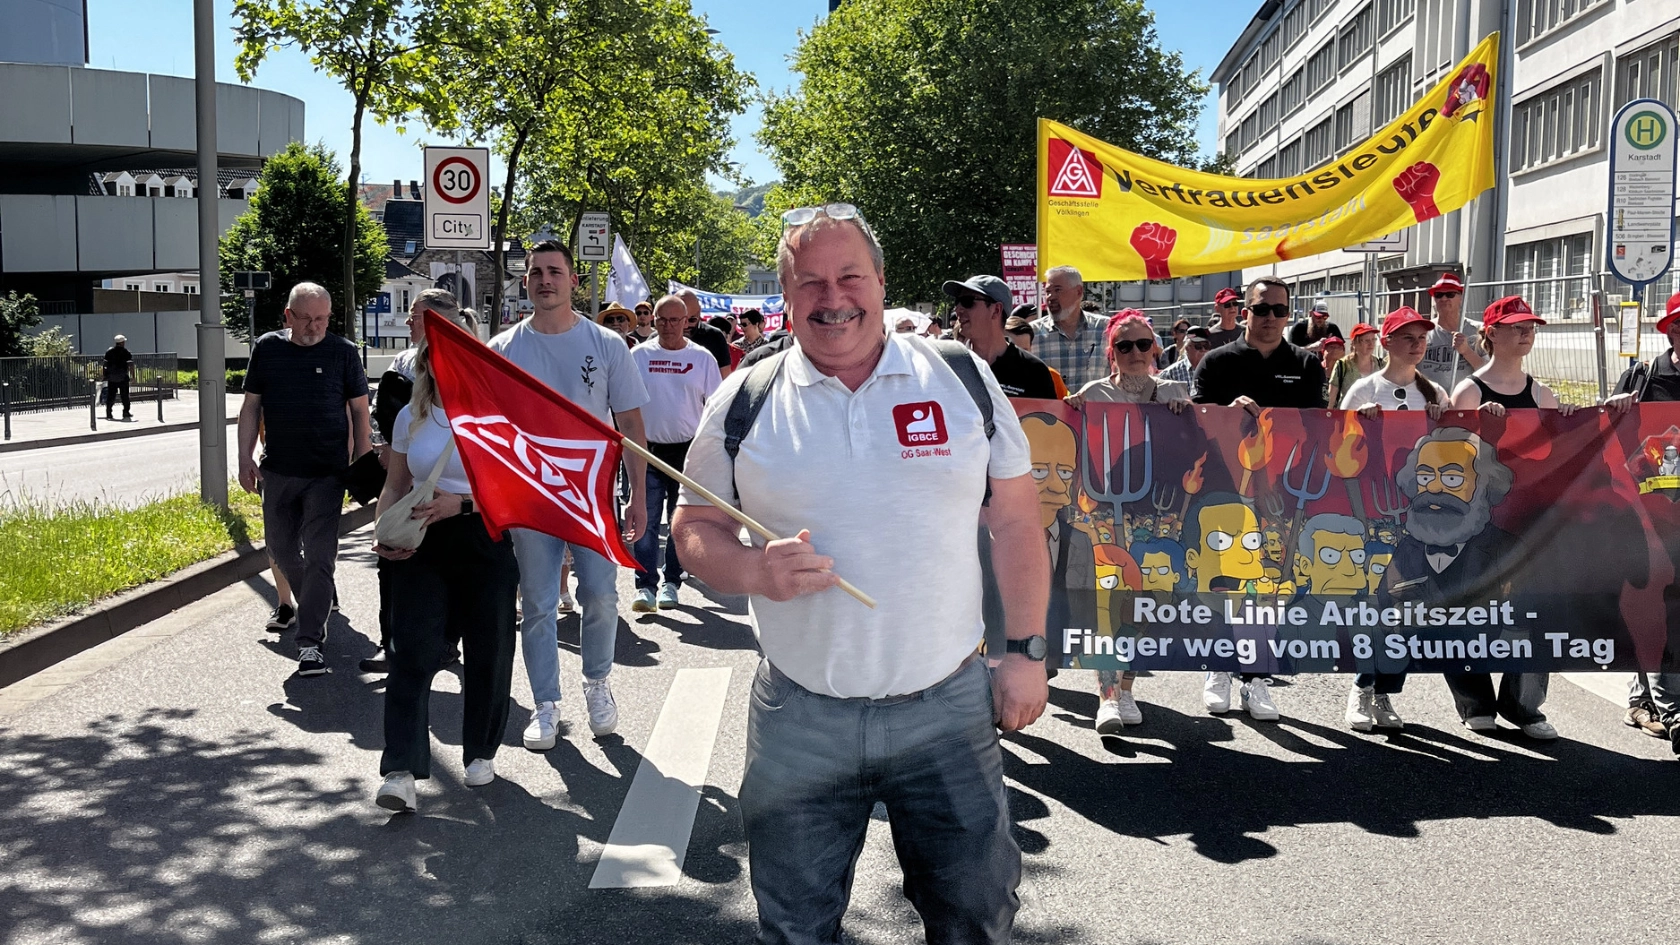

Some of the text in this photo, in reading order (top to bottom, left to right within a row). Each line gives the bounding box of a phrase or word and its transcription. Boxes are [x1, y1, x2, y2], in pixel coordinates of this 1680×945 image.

[1637, 120, 1654, 141] H
[1104, 108, 1438, 208] Vertrauensleute
[443, 169, 470, 191] 30
[1056, 209, 1090, 217] Völklingen
[1240, 192, 1366, 244] saarstahl
[443, 219, 472, 237] City
[908, 432, 939, 442] IGBCE
[901, 448, 952, 459] OG Saar-West
[1133, 597, 1212, 625] Rote
[1224, 599, 1308, 625] Linie
[1319, 600, 1515, 626] Arbeitszeit
[1063, 628, 1615, 664] Finger weg vom 8 Stunden Tag
